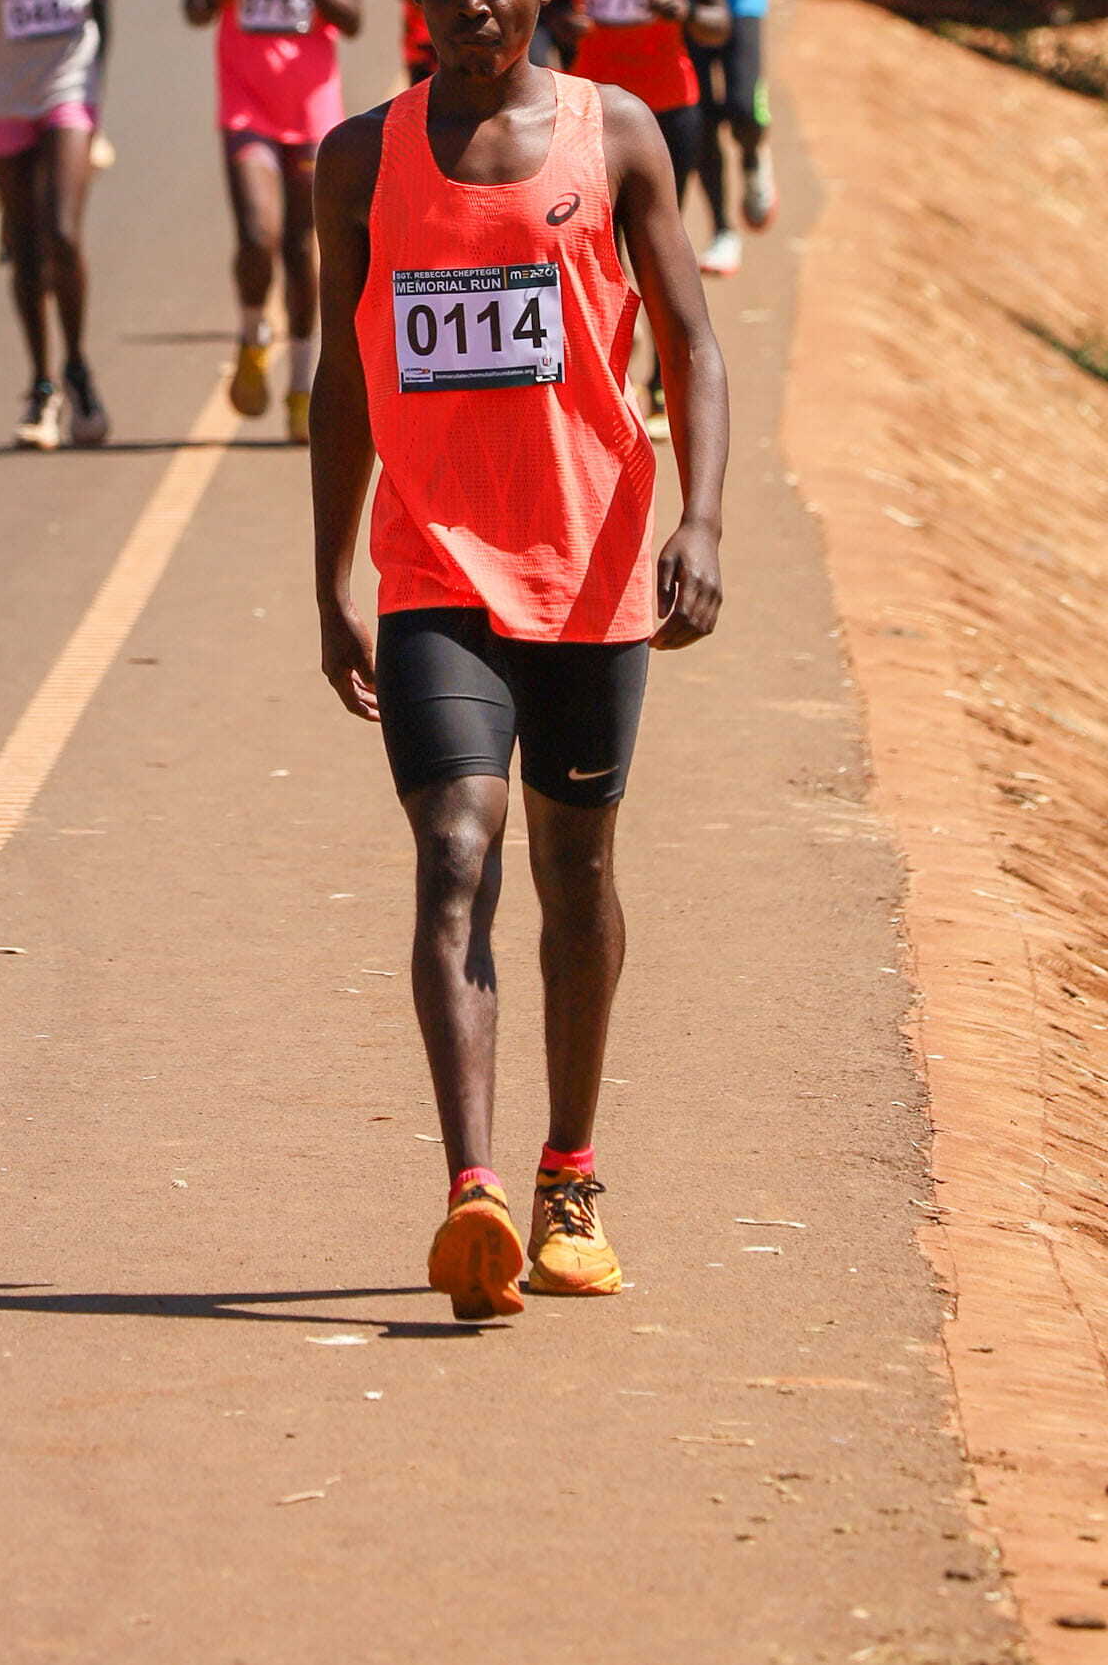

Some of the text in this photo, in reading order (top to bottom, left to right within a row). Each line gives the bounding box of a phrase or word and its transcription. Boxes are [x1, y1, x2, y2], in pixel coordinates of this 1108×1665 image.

[414, 270, 452, 280] REBECCA
[452, 268, 501, 278] CHEPTEGEI
[396, 277, 502, 294] MEMORIAL RUN
[406, 296, 547, 357] 0114
